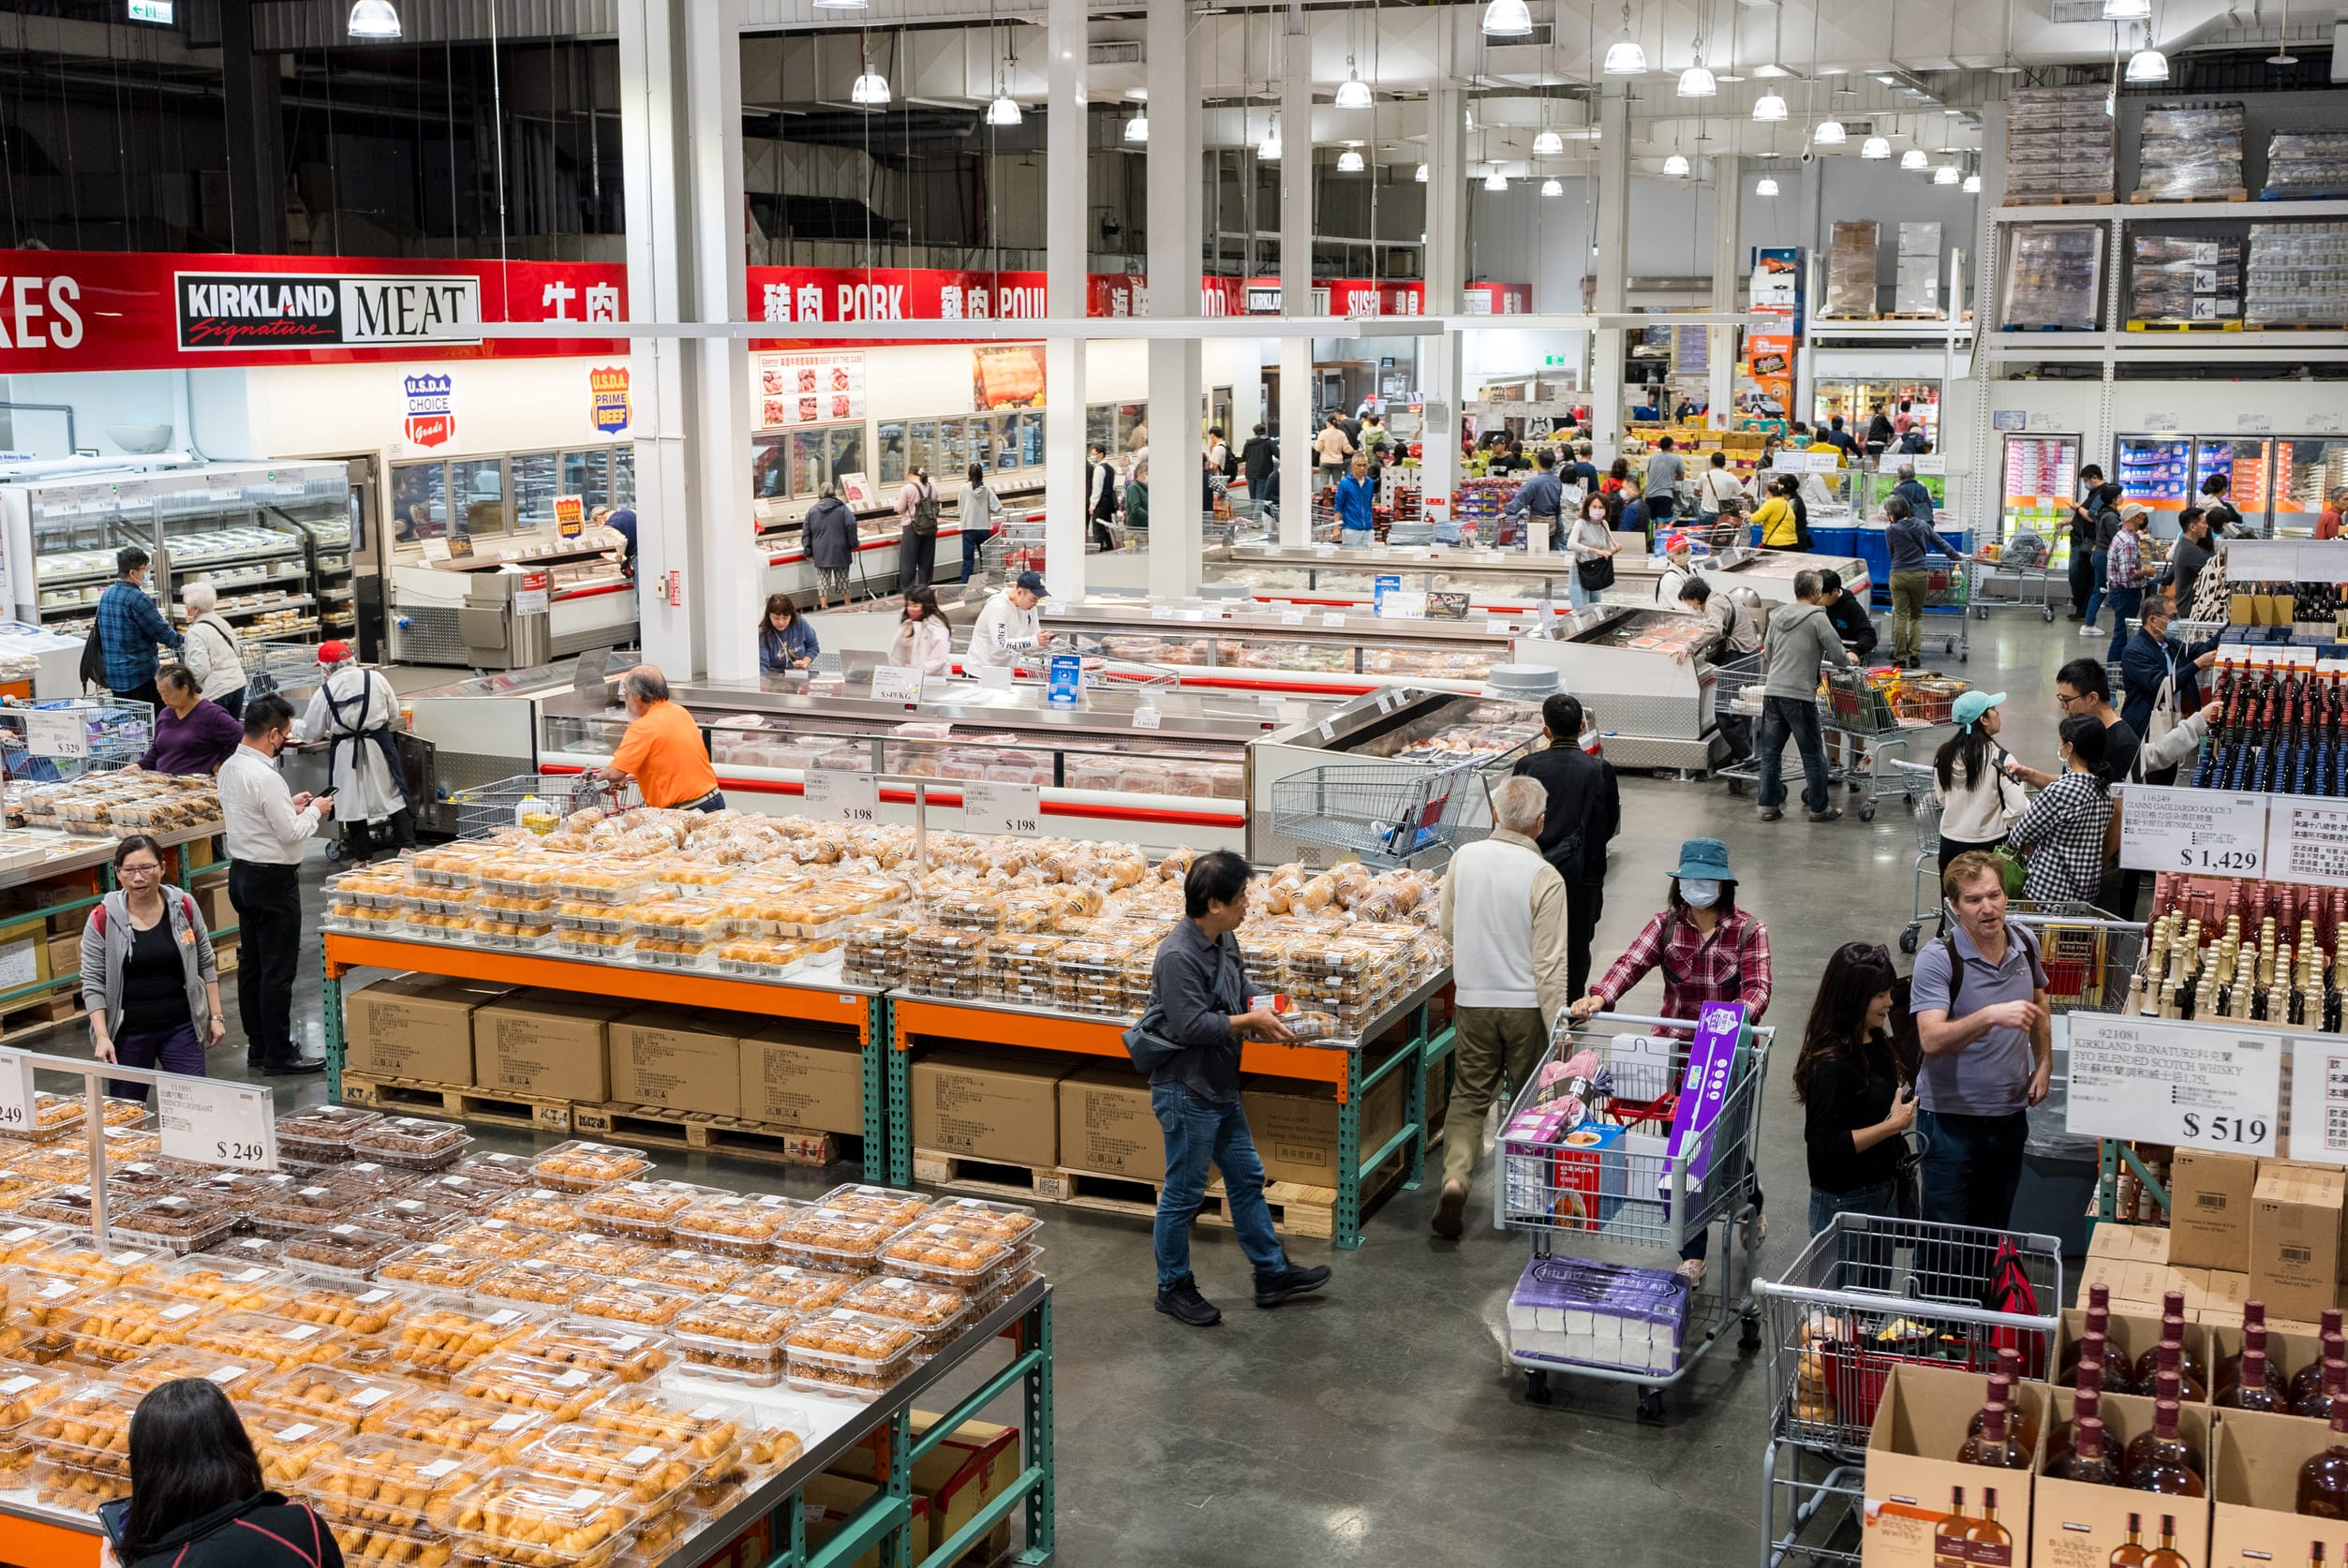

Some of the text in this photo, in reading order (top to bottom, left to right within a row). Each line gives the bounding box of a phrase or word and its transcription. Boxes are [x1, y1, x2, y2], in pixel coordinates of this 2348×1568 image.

[188, 284, 334, 317] KIRKLAND
[542, 281, 619, 322] 牛肉
[764, 283, 903, 322] 豬肉 PORK
[1347, 289, 1381, 316] SUSHI
[354, 285, 465, 336] MEAT
[188, 318, 335, 346] Signature
[407, 378, 450, 393] U.S.D.A.
[592, 373, 628, 391] U.S.D.A.
[409, 397, 449, 412] CHOICE
[595, 393, 626, 405] PRIME
[598, 408, 626, 425] BEEF
[414, 422, 443, 444] Grade
[562, 524, 580, 535] BEEF
[1006, 641, 1032, 650] RALPH
[66, 743, 80, 753] 329
[843, 807, 872, 821] $ 198
[2125, 801, 2153, 810] GIANNI
[2154, 804, 2200, 813] GAGLIARDO
[2200, 806, 2227, 815] DOLCE
[1005, 819, 1035, 832] $ 198
[2180, 849, 2257, 870] $ 1,429
[2099, 1028, 2139, 1042] 921081
[2074, 1038, 2132, 1052] KIRKLAND
[2073, 1050, 2243, 1076] 3YO BLENDED SCOTCH WHISKY
[2183, 1112, 2266, 1145] $ 519
[217, 1141, 262, 1161] $ 249
